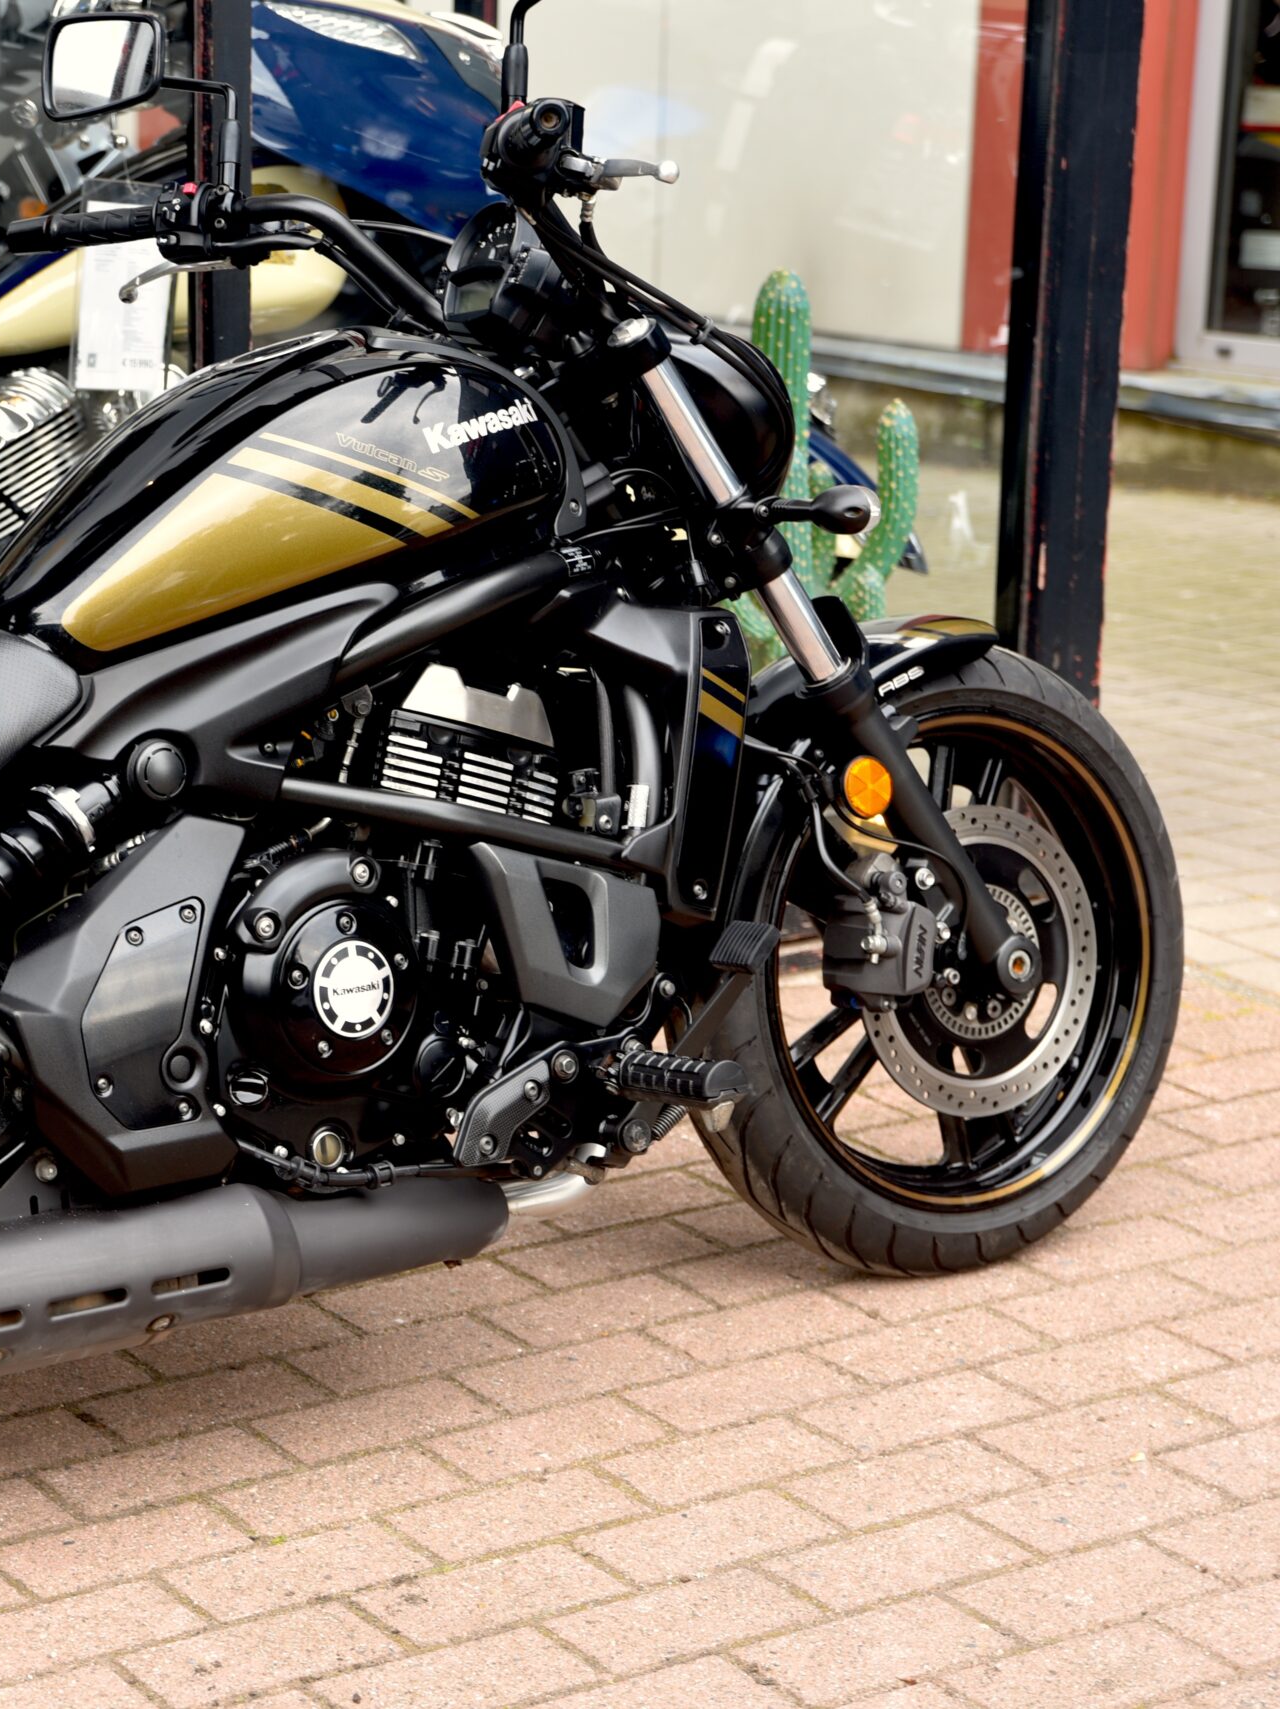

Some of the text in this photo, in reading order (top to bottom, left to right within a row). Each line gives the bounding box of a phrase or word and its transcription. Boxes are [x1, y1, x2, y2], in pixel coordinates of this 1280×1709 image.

[422, 397, 538, 454] Kawasaki
[336, 432, 449, 482] Vulcan S
[877, 665, 925, 697] ABS
[332, 980, 380, 997] Kawasaki
